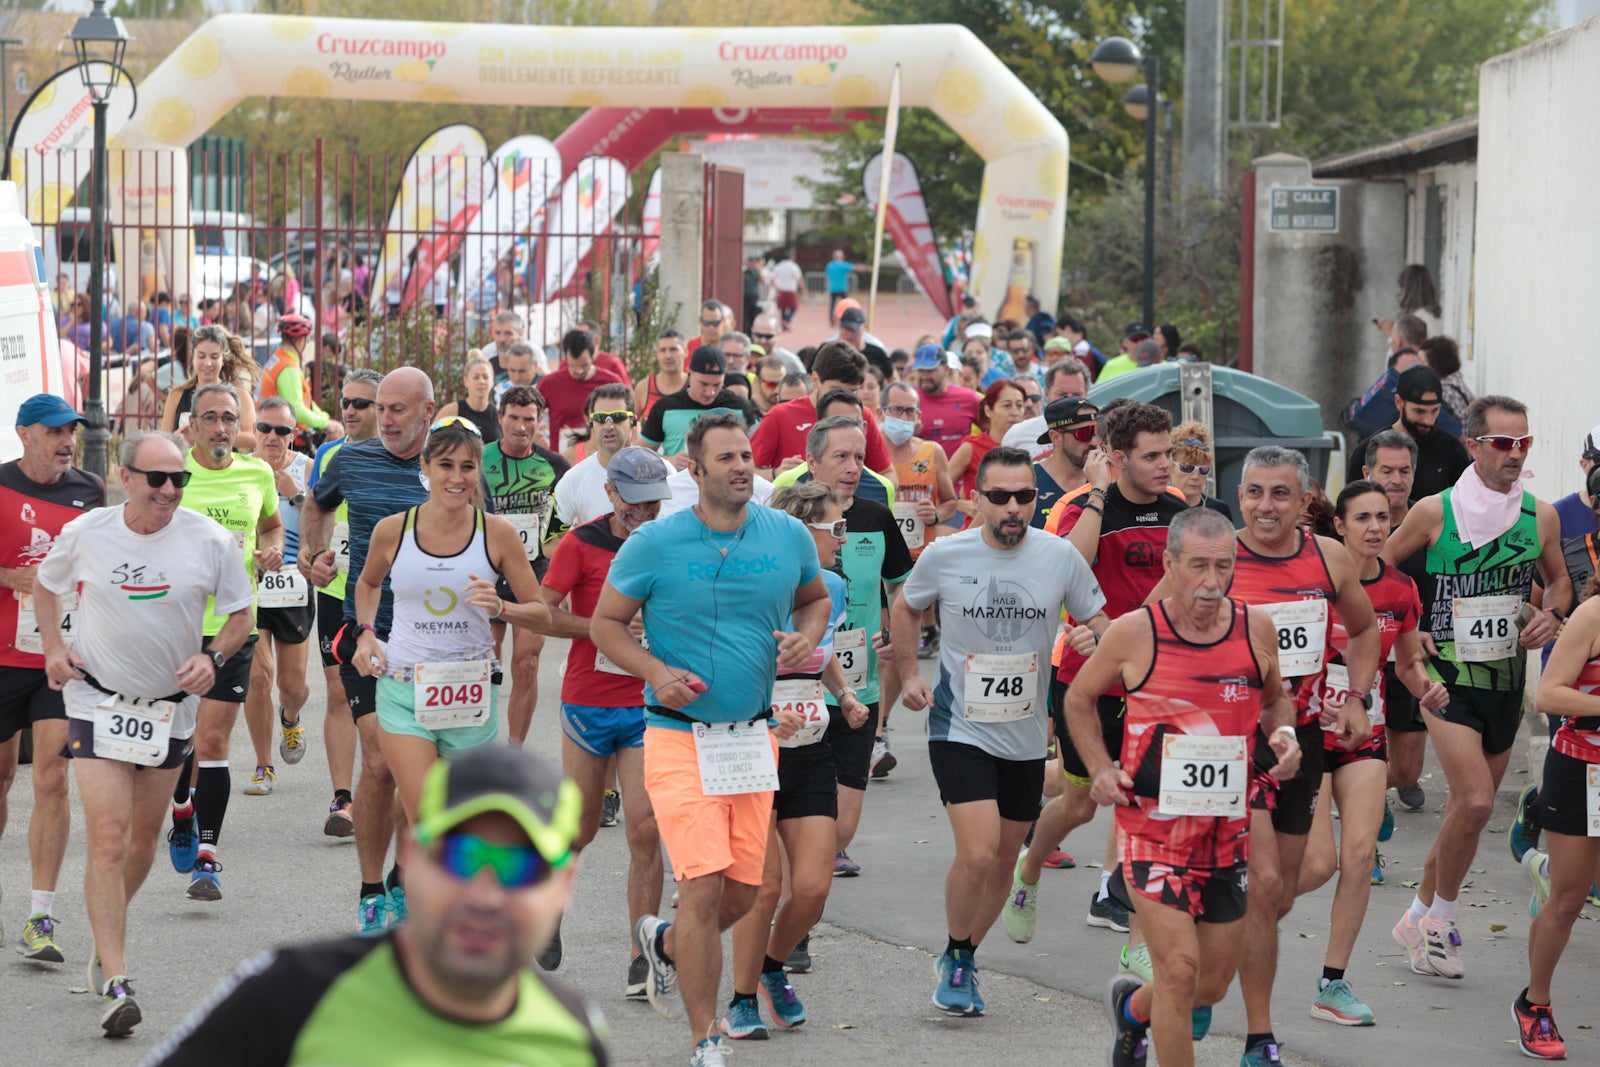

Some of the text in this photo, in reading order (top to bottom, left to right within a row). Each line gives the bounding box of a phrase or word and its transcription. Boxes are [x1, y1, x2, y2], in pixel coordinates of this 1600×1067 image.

[317, 32, 446, 59] Cruzcampo
[718, 40, 847, 63] Cruzcampo
[329, 60, 392, 83] Radler
[730, 67, 793, 89] Radler
[1293, 191, 1331, 203] CALLE
[226, 519, 248, 527] FONDO
[895, 517, 915, 532] 79
[687, 553, 780, 581] Reebok
[265, 575, 295, 590] 861
[1435, 574, 1475, 601] TEAM
[992, 597, 1016, 605] HALB
[963, 606, 1046, 619] MARATHON
[415, 621, 469, 630] OKEYMAS
[1470, 618, 1508, 639] 418
[1278, 626, 1308, 650] 86
[425, 684, 483, 706] 2049
[981, 676, 1023, 697] 748
[109, 714, 153, 741] 309
[706, 750, 762, 764] YO CORRO CONTRA
[719, 764, 726, 775] EL
[1182, 763, 1229, 788] 301
